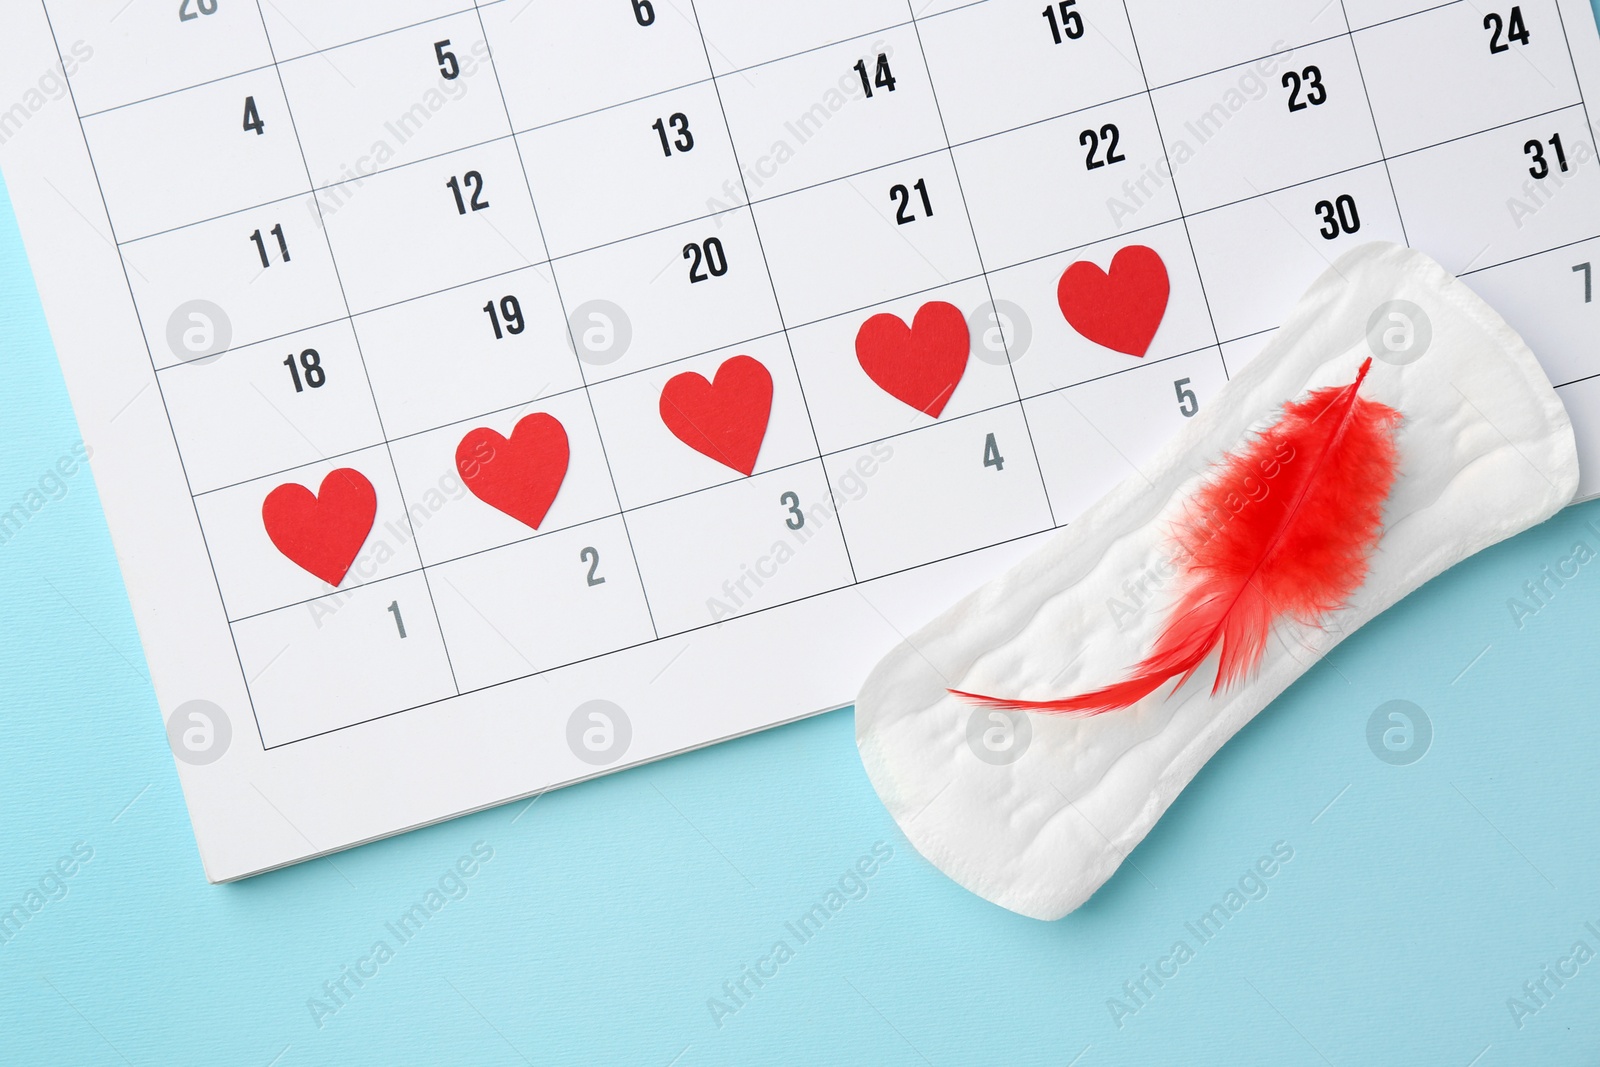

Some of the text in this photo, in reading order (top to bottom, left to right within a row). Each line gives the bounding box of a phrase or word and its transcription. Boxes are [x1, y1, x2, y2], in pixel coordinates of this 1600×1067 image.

[631, 0, 655, 27] 6
[1042, 0, 1084, 44] 15
[1483, 6, 1530, 55] 24
[434, 39, 459, 80] 5
[853, 53, 896, 98] 14
[1281, 65, 1327, 113] 23
[243, 96, 264, 135] 4
[652, 112, 694, 157] 13
[1079, 123, 1126, 171] 22
[1524, 133, 1568, 179] 31
[446, 170, 489, 215] 12
[890, 178, 933, 225] 21
[1315, 194, 1360, 240] 30
[250, 223, 291, 268] 11
[683, 237, 728, 284] 20
[1572, 262, 1592, 303] 7
[483, 295, 525, 339] 19
[283, 349, 325, 393] 18
[1174, 377, 1198, 417] 5
[983, 433, 1004, 471] 4
[780, 491, 804, 530] 3
[580, 547, 605, 587] 2
[388, 601, 407, 638] 1
